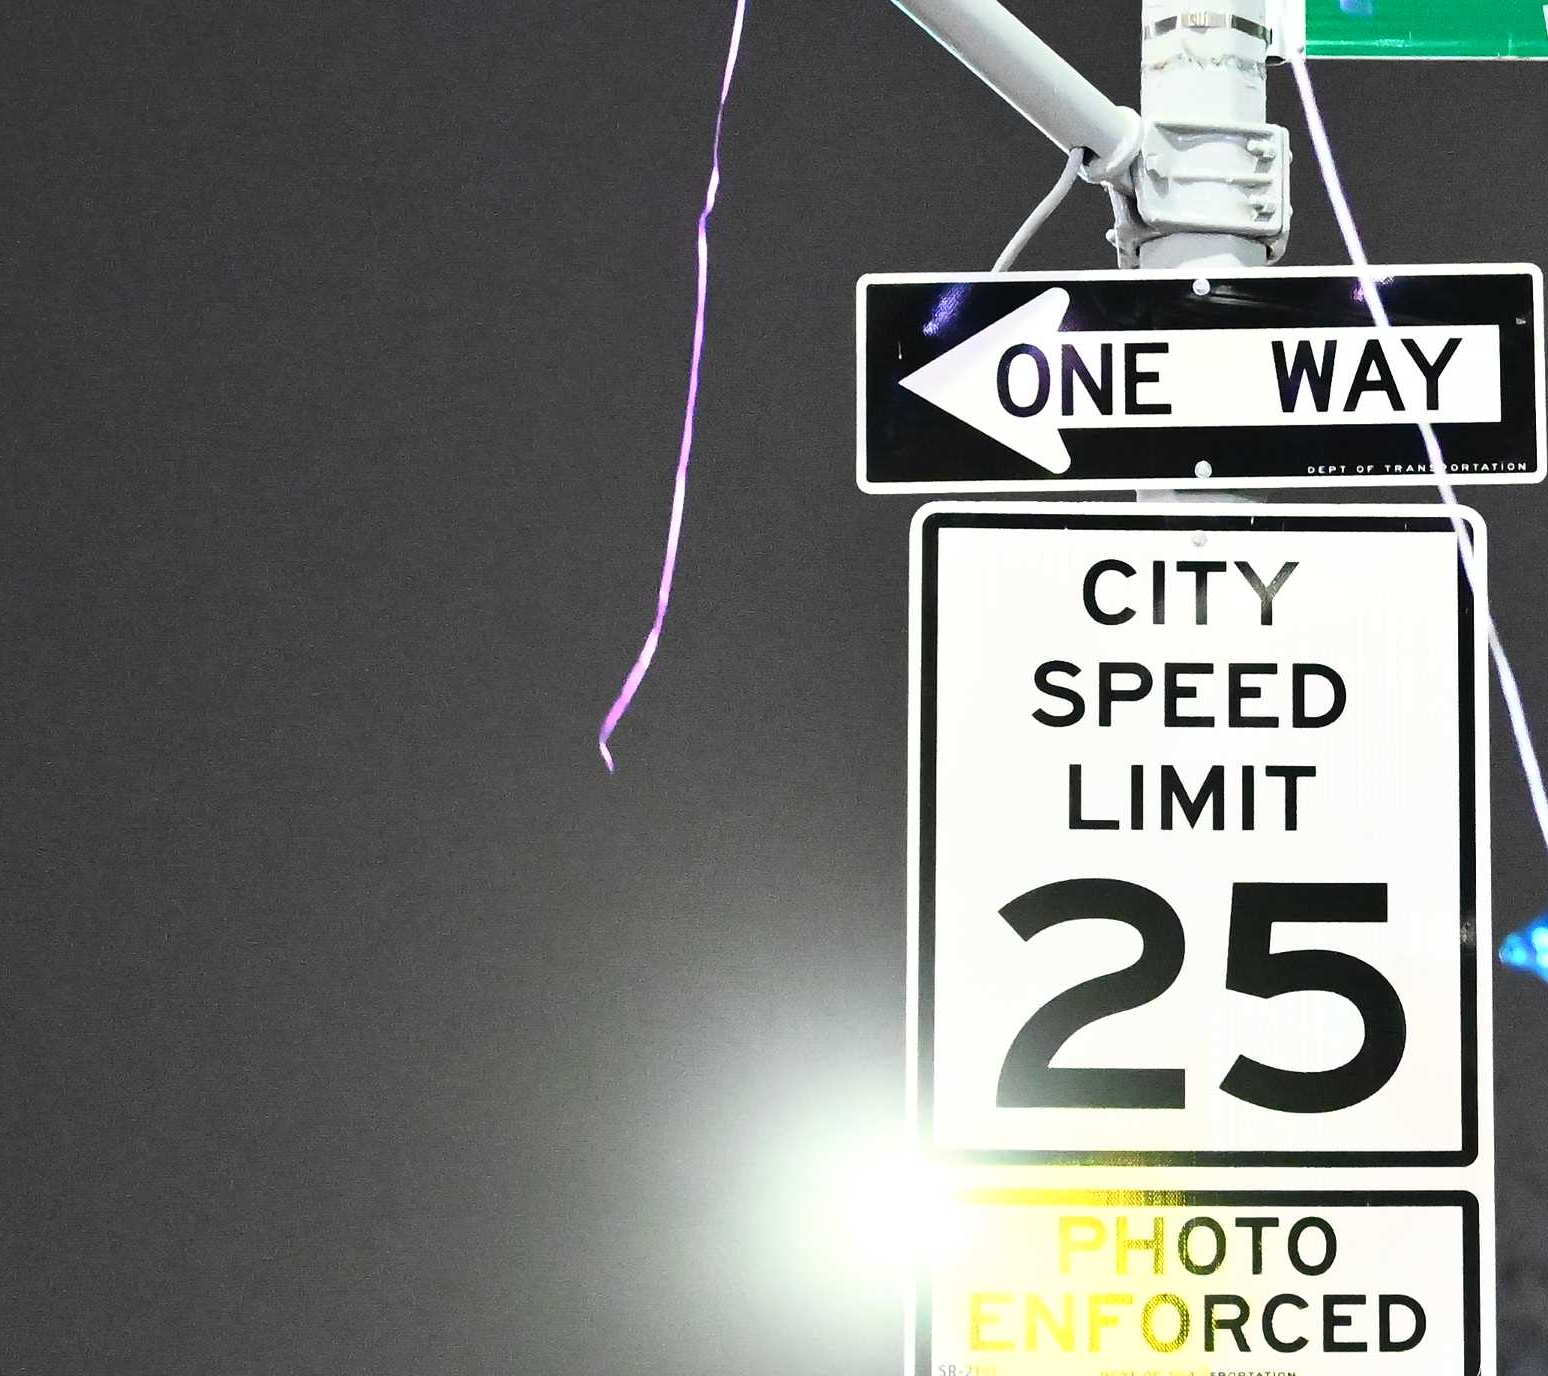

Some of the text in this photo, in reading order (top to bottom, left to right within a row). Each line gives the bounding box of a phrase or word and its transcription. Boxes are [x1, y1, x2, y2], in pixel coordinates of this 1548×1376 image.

[995, 336, 1463, 418] ONE WAY
[1307, 464, 1347, 475] DEPT
[1356, 464, 1375, 474] OF
[1082, 558, 1301, 626] CITY
[1031, 661, 1348, 729] SPEED
[1068, 764, 1317, 832] LIMIT
[996, 877, 1408, 1115] 25
[1056, 1216, 1338, 1277] PHOTO
[968, 1293, 1428, 1354] ENFORCED
